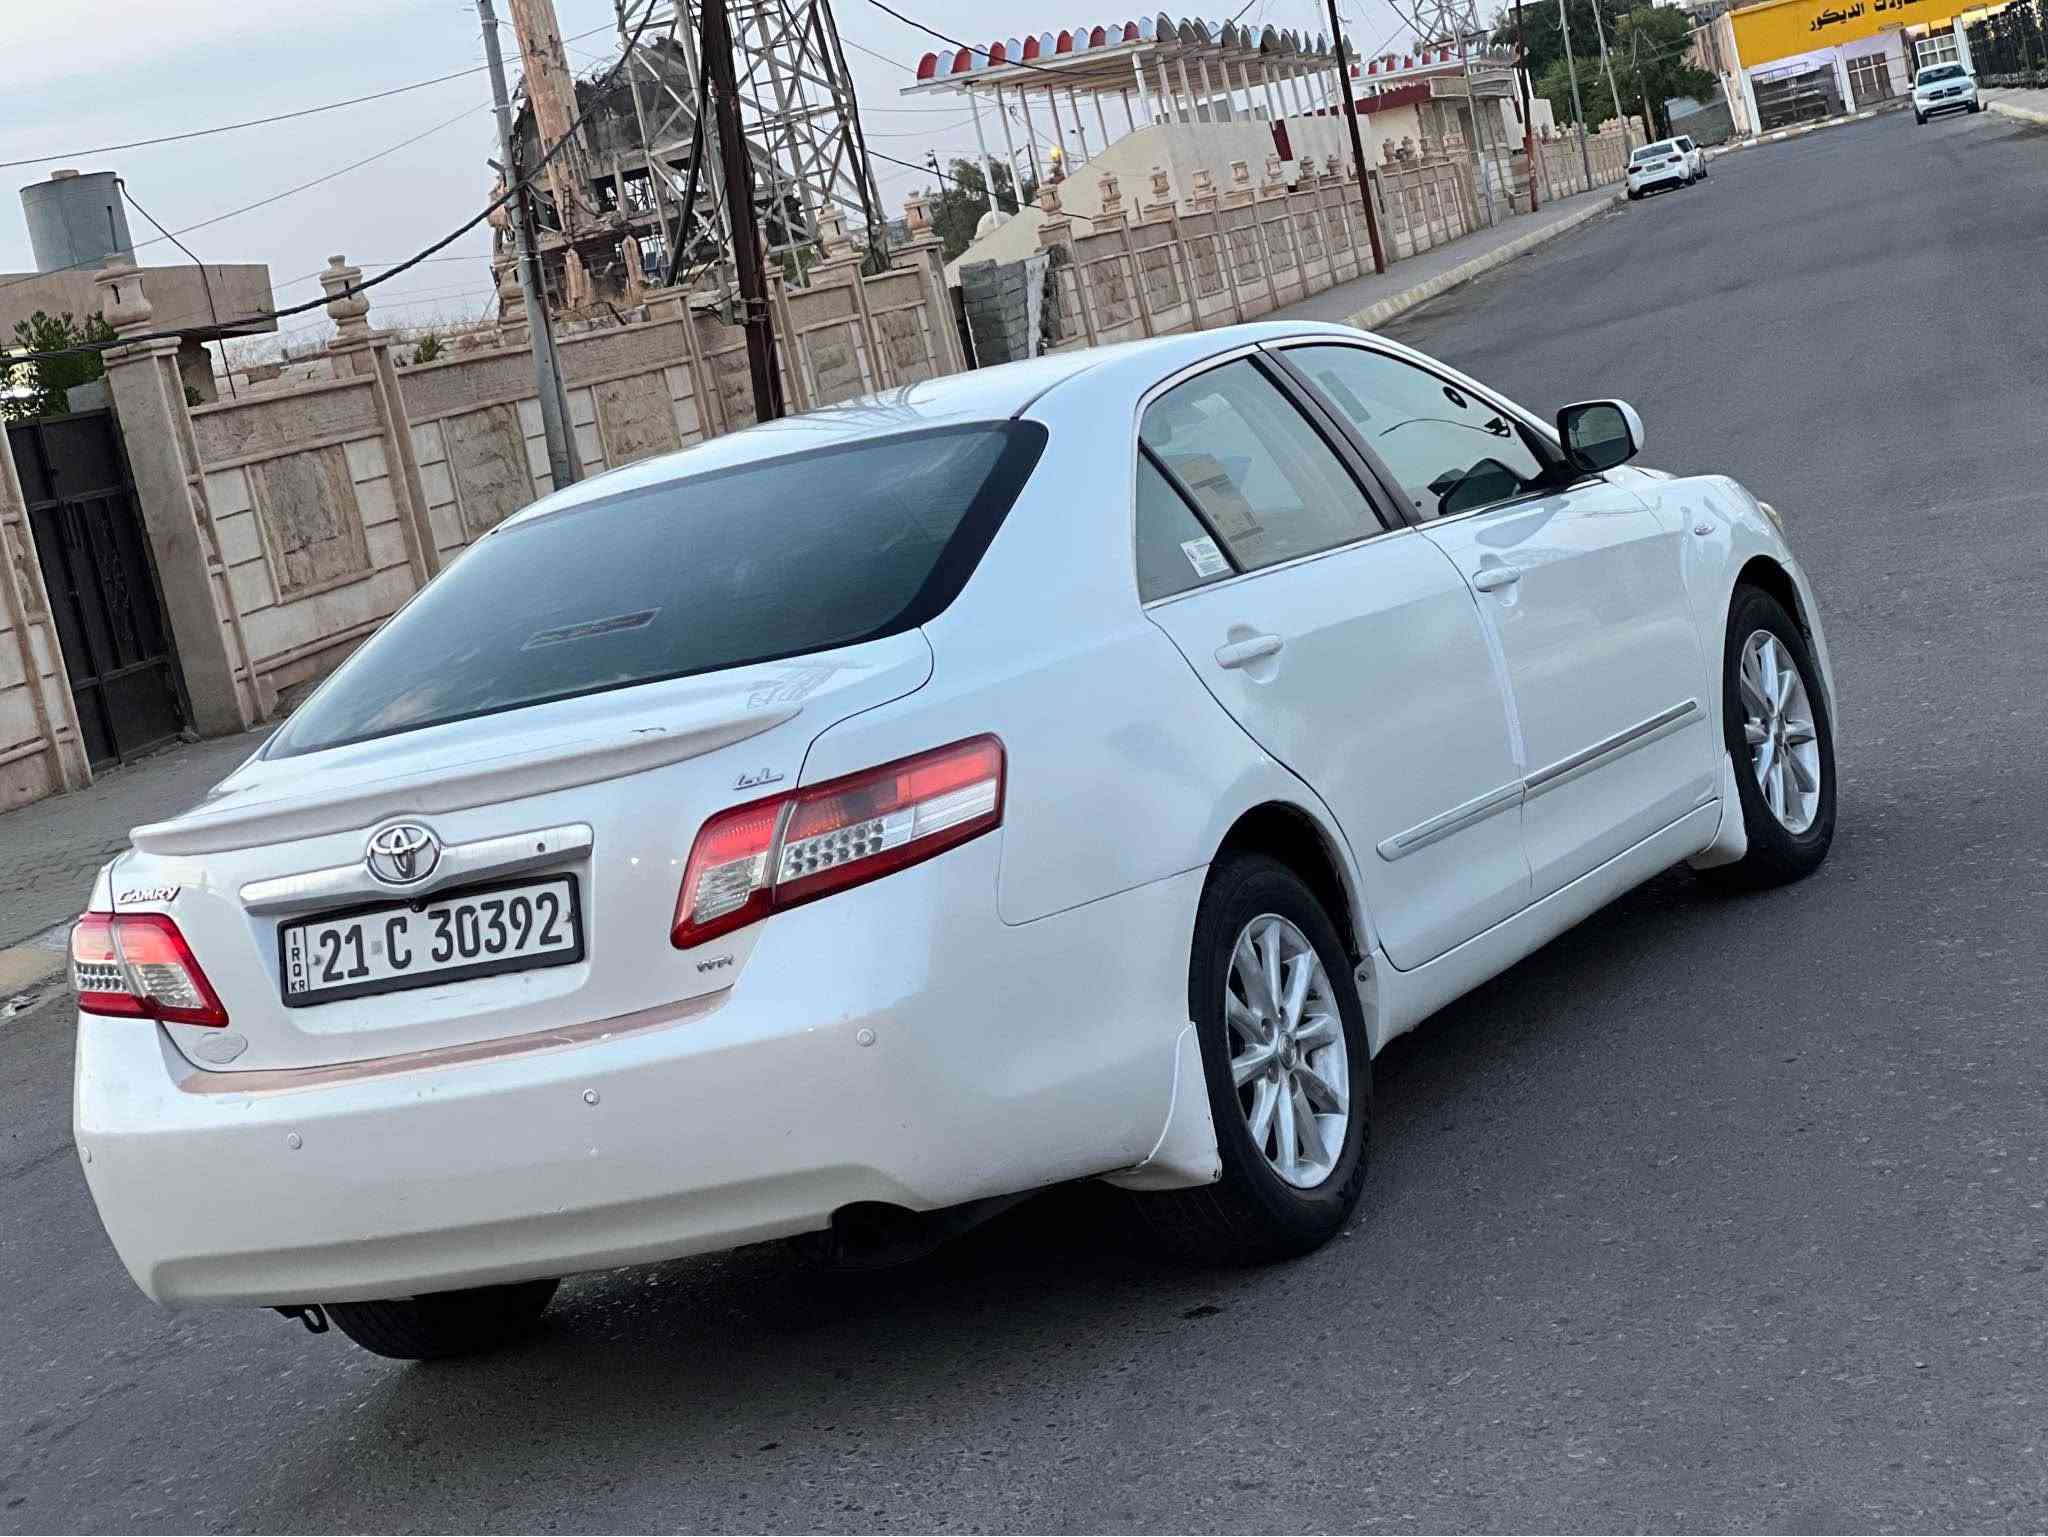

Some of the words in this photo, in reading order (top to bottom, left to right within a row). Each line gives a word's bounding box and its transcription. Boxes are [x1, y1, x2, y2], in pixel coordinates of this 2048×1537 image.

[1808, 3, 1865, 31] الديكور
[118, 886, 181, 905] CAMRY
[319, 924, 370, 983] 21
[385, 916, 413, 970] C
[427, 892, 562, 963] 30392
[290, 980, 306, 993] KR
